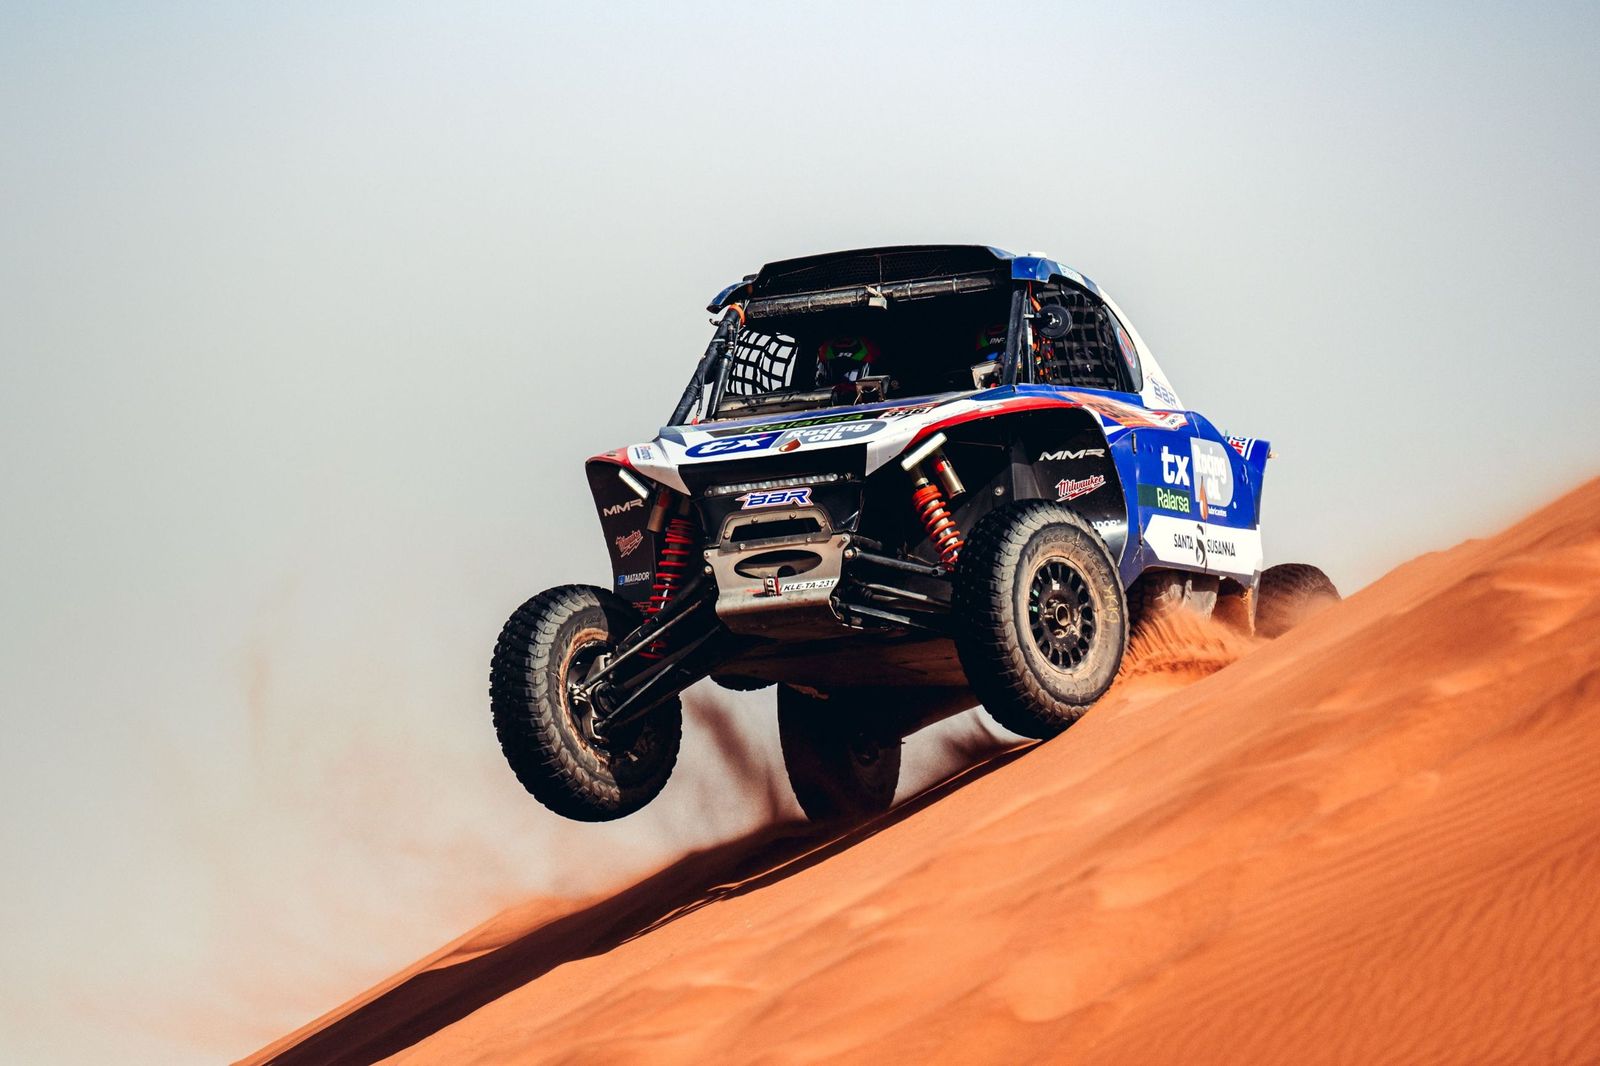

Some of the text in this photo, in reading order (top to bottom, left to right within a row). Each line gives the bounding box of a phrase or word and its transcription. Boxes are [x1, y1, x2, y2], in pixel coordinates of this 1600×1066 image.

[745, 411, 866, 434] Ralarsa
[785, 420, 873, 439] Racing
[1038, 448, 1106, 462] MMR
[1192, 443, 1227, 485] Racing
[1161, 446, 1190, 487] tx
[1055, 474, 1105, 498] Milwaukee
[602, 498, 645, 517] MMR
[744, 488, 811, 508] BBR
[1156, 487, 1190, 514] Ralarsa
[1173, 533, 1237, 557] SANTA SUSANNA
[624, 571, 651, 584] MATADOR
[783, 579, 835, 592] KLE-TA-231
